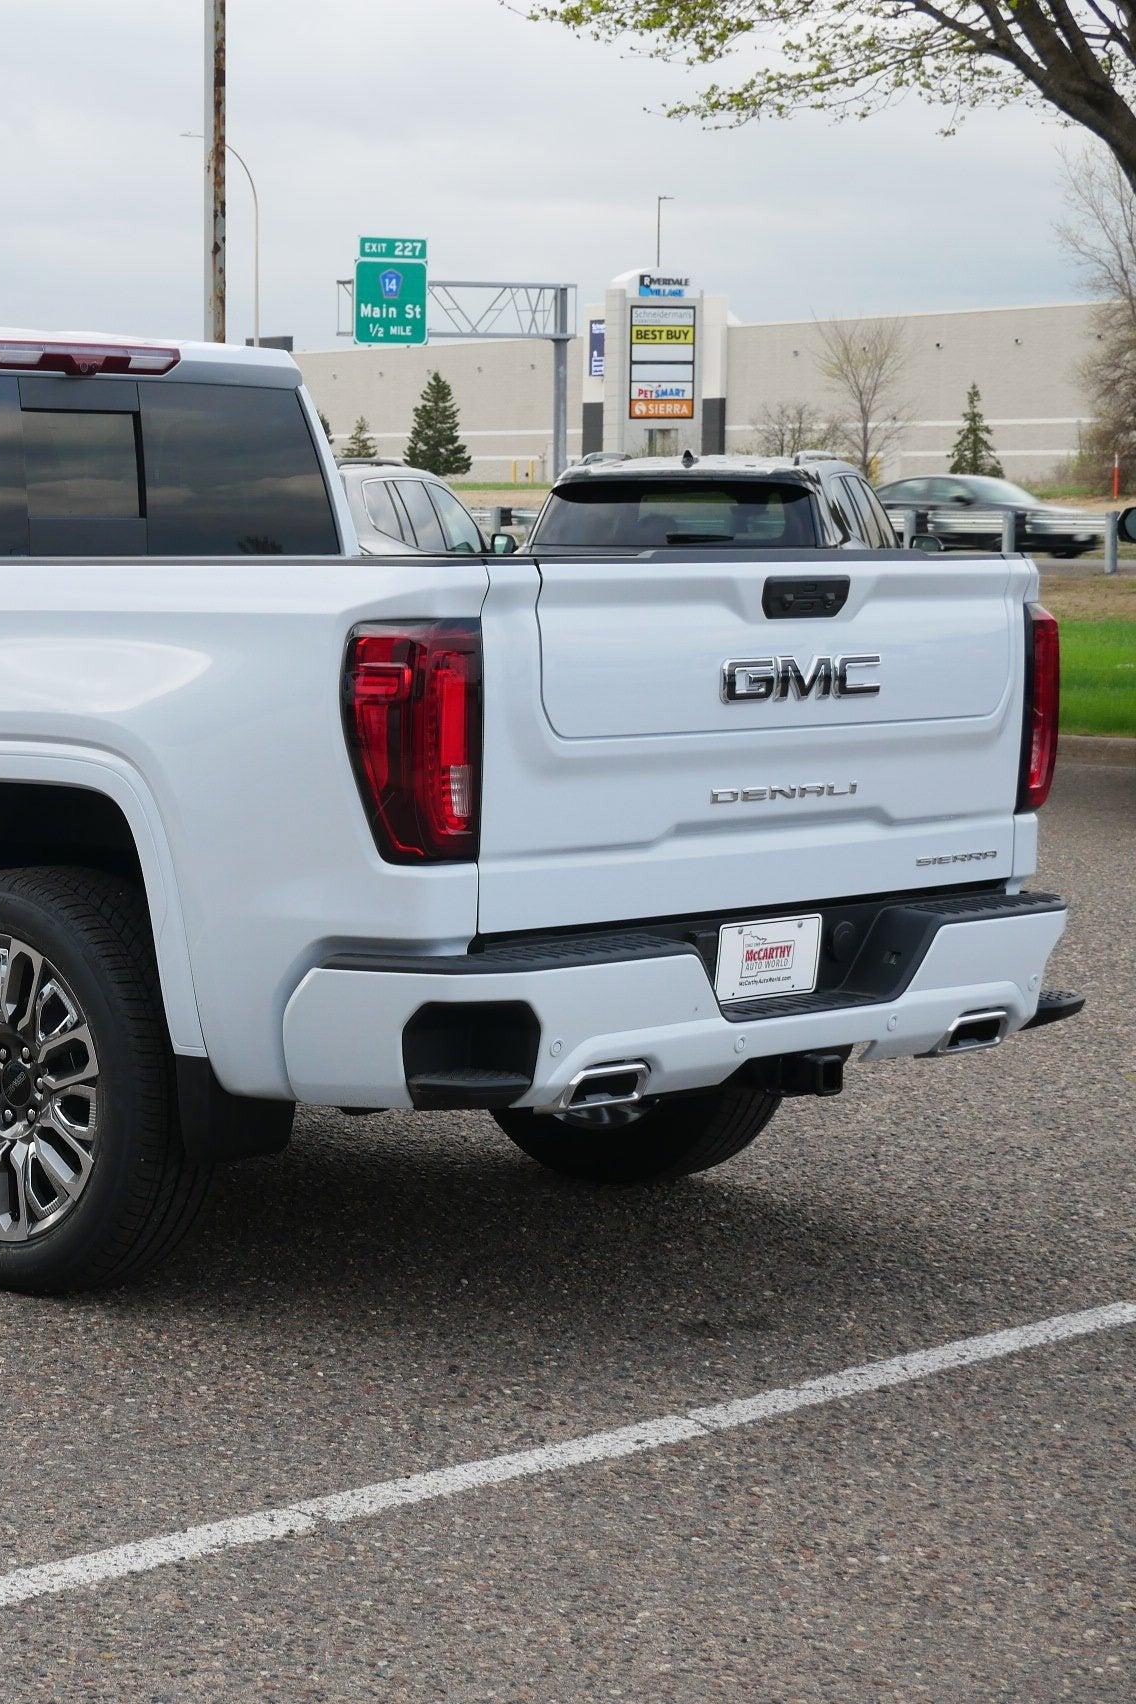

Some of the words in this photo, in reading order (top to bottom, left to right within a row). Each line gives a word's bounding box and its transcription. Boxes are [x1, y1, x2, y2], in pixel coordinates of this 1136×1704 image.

[365, 243, 387, 253] EXIT
[394, 242, 422, 256] 227
[385, 279, 397, 292] 14
[650, 288, 684, 297] VILLAGE
[360, 303, 397, 318] Main
[405, 304, 421, 319] St
[390, 326, 412, 336] MILE
[635, 330, 664, 340] BEST
[666, 330, 690, 340] BUY
[648, 404, 689, 414] SIERRA
[720, 653, 881, 704] GMC
[709, 780, 858, 805] DENALI
[915, 850, 998, 867] SIERRA
[745, 944, 792, 962] McCARTHY
[745, 962, 763, 972] AUTO
[764, 958, 789, 969] WORLD
